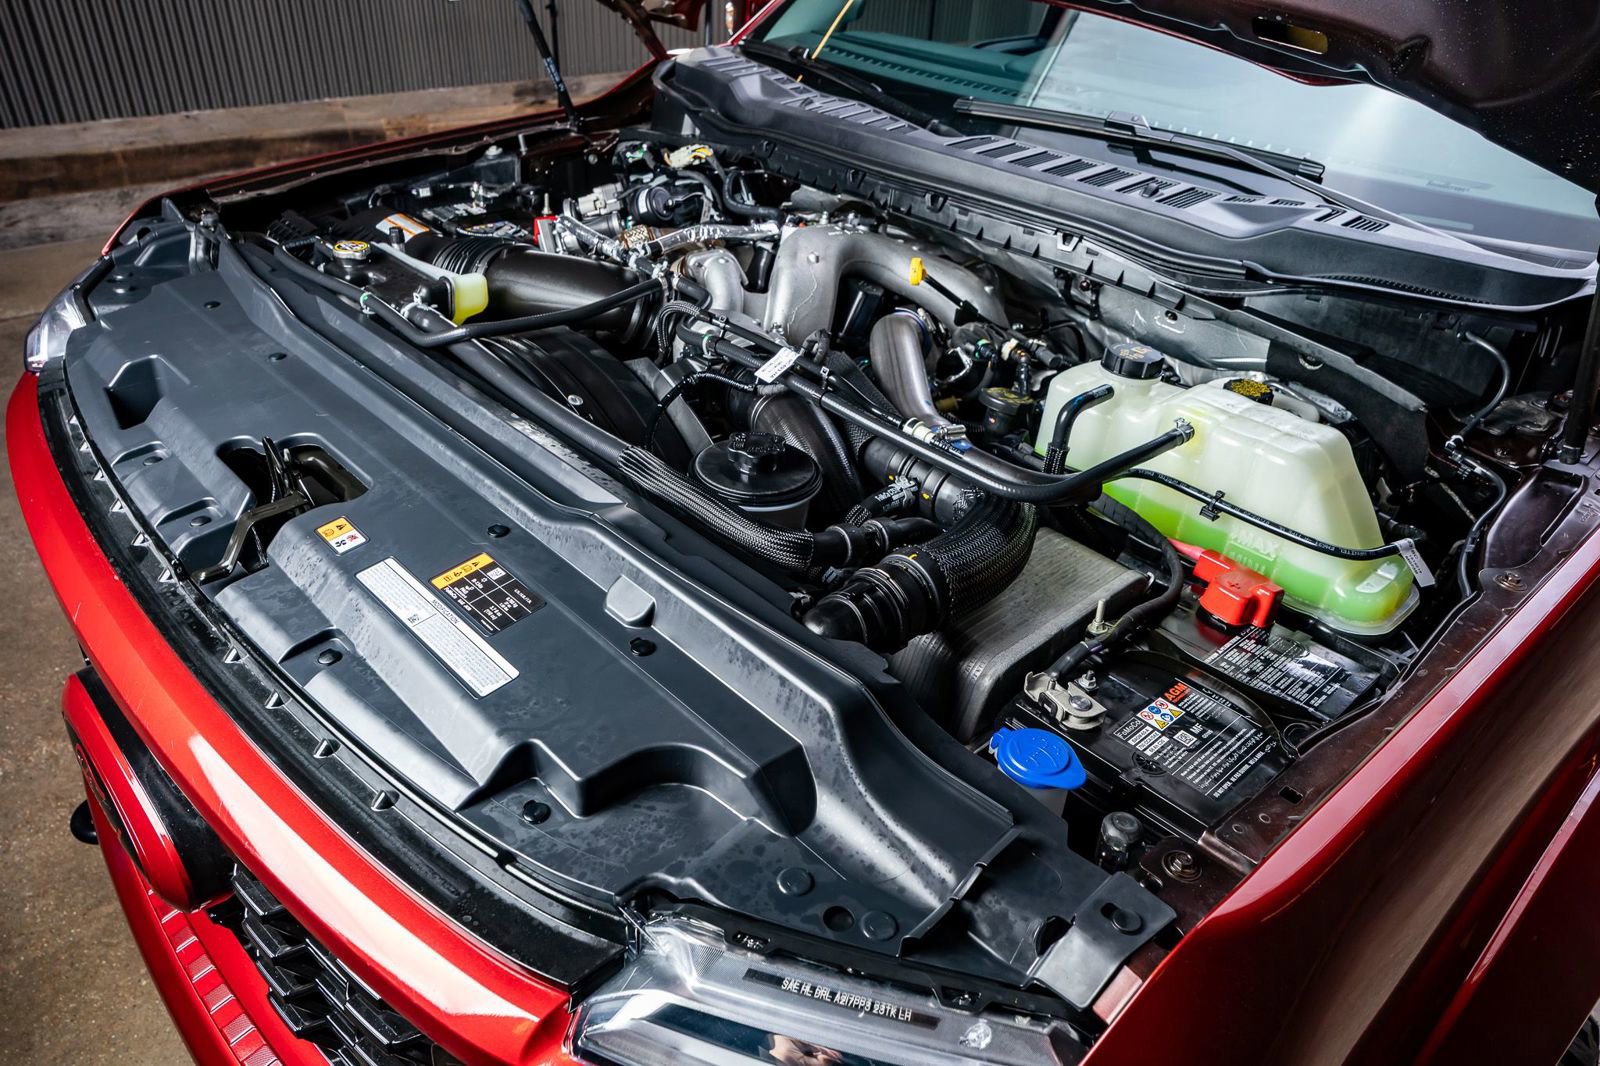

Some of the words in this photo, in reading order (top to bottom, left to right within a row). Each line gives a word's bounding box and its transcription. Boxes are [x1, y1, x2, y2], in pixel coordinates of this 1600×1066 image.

[1164, 682, 1188, 701] AGM
[1116, 720, 1142, 740] FoMoCo
[781, 976, 801, 993] SAE
[800, 982, 813, 996] HL
[814, 985, 832, 1002] DRL
[899, 1006, 912, 1022] LH
